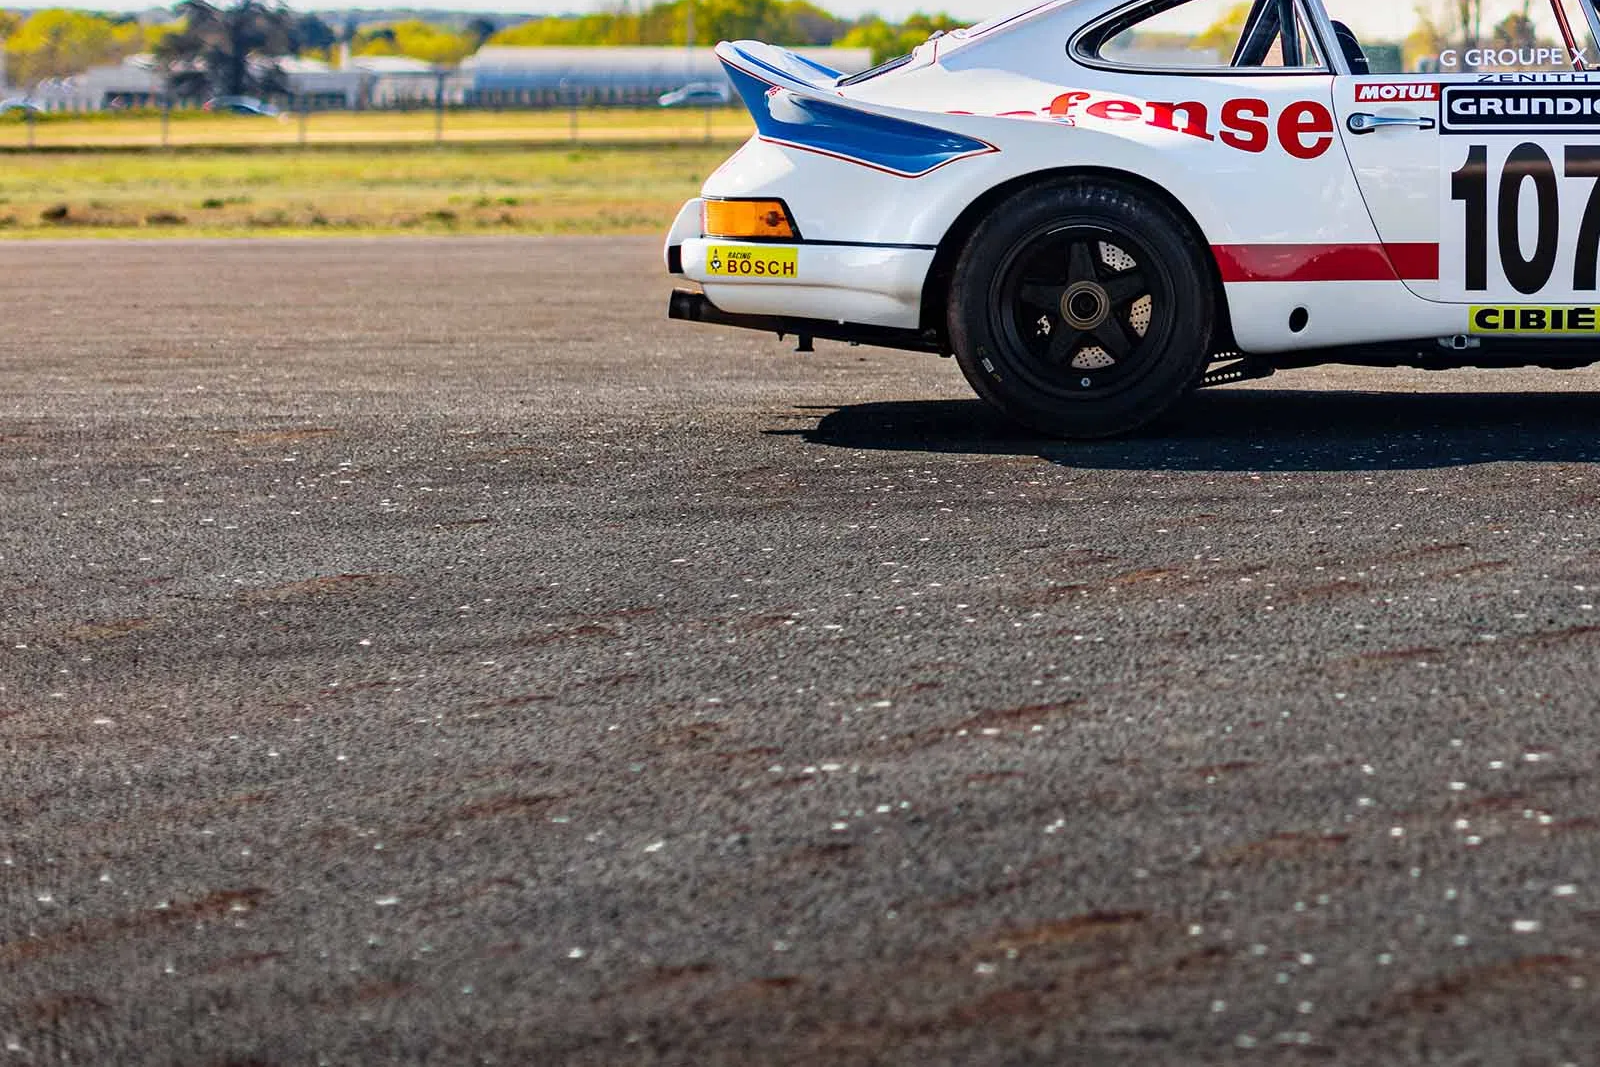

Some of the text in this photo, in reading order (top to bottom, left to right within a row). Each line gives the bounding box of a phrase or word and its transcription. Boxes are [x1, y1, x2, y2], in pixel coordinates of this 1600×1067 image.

[1440, 47, 1589, 67] G GROUPE X
[1478, 73, 1589, 83] ZENITH
[1358, 84, 1437, 100] MOTUL
[727, 260, 795, 275] BOSCH
